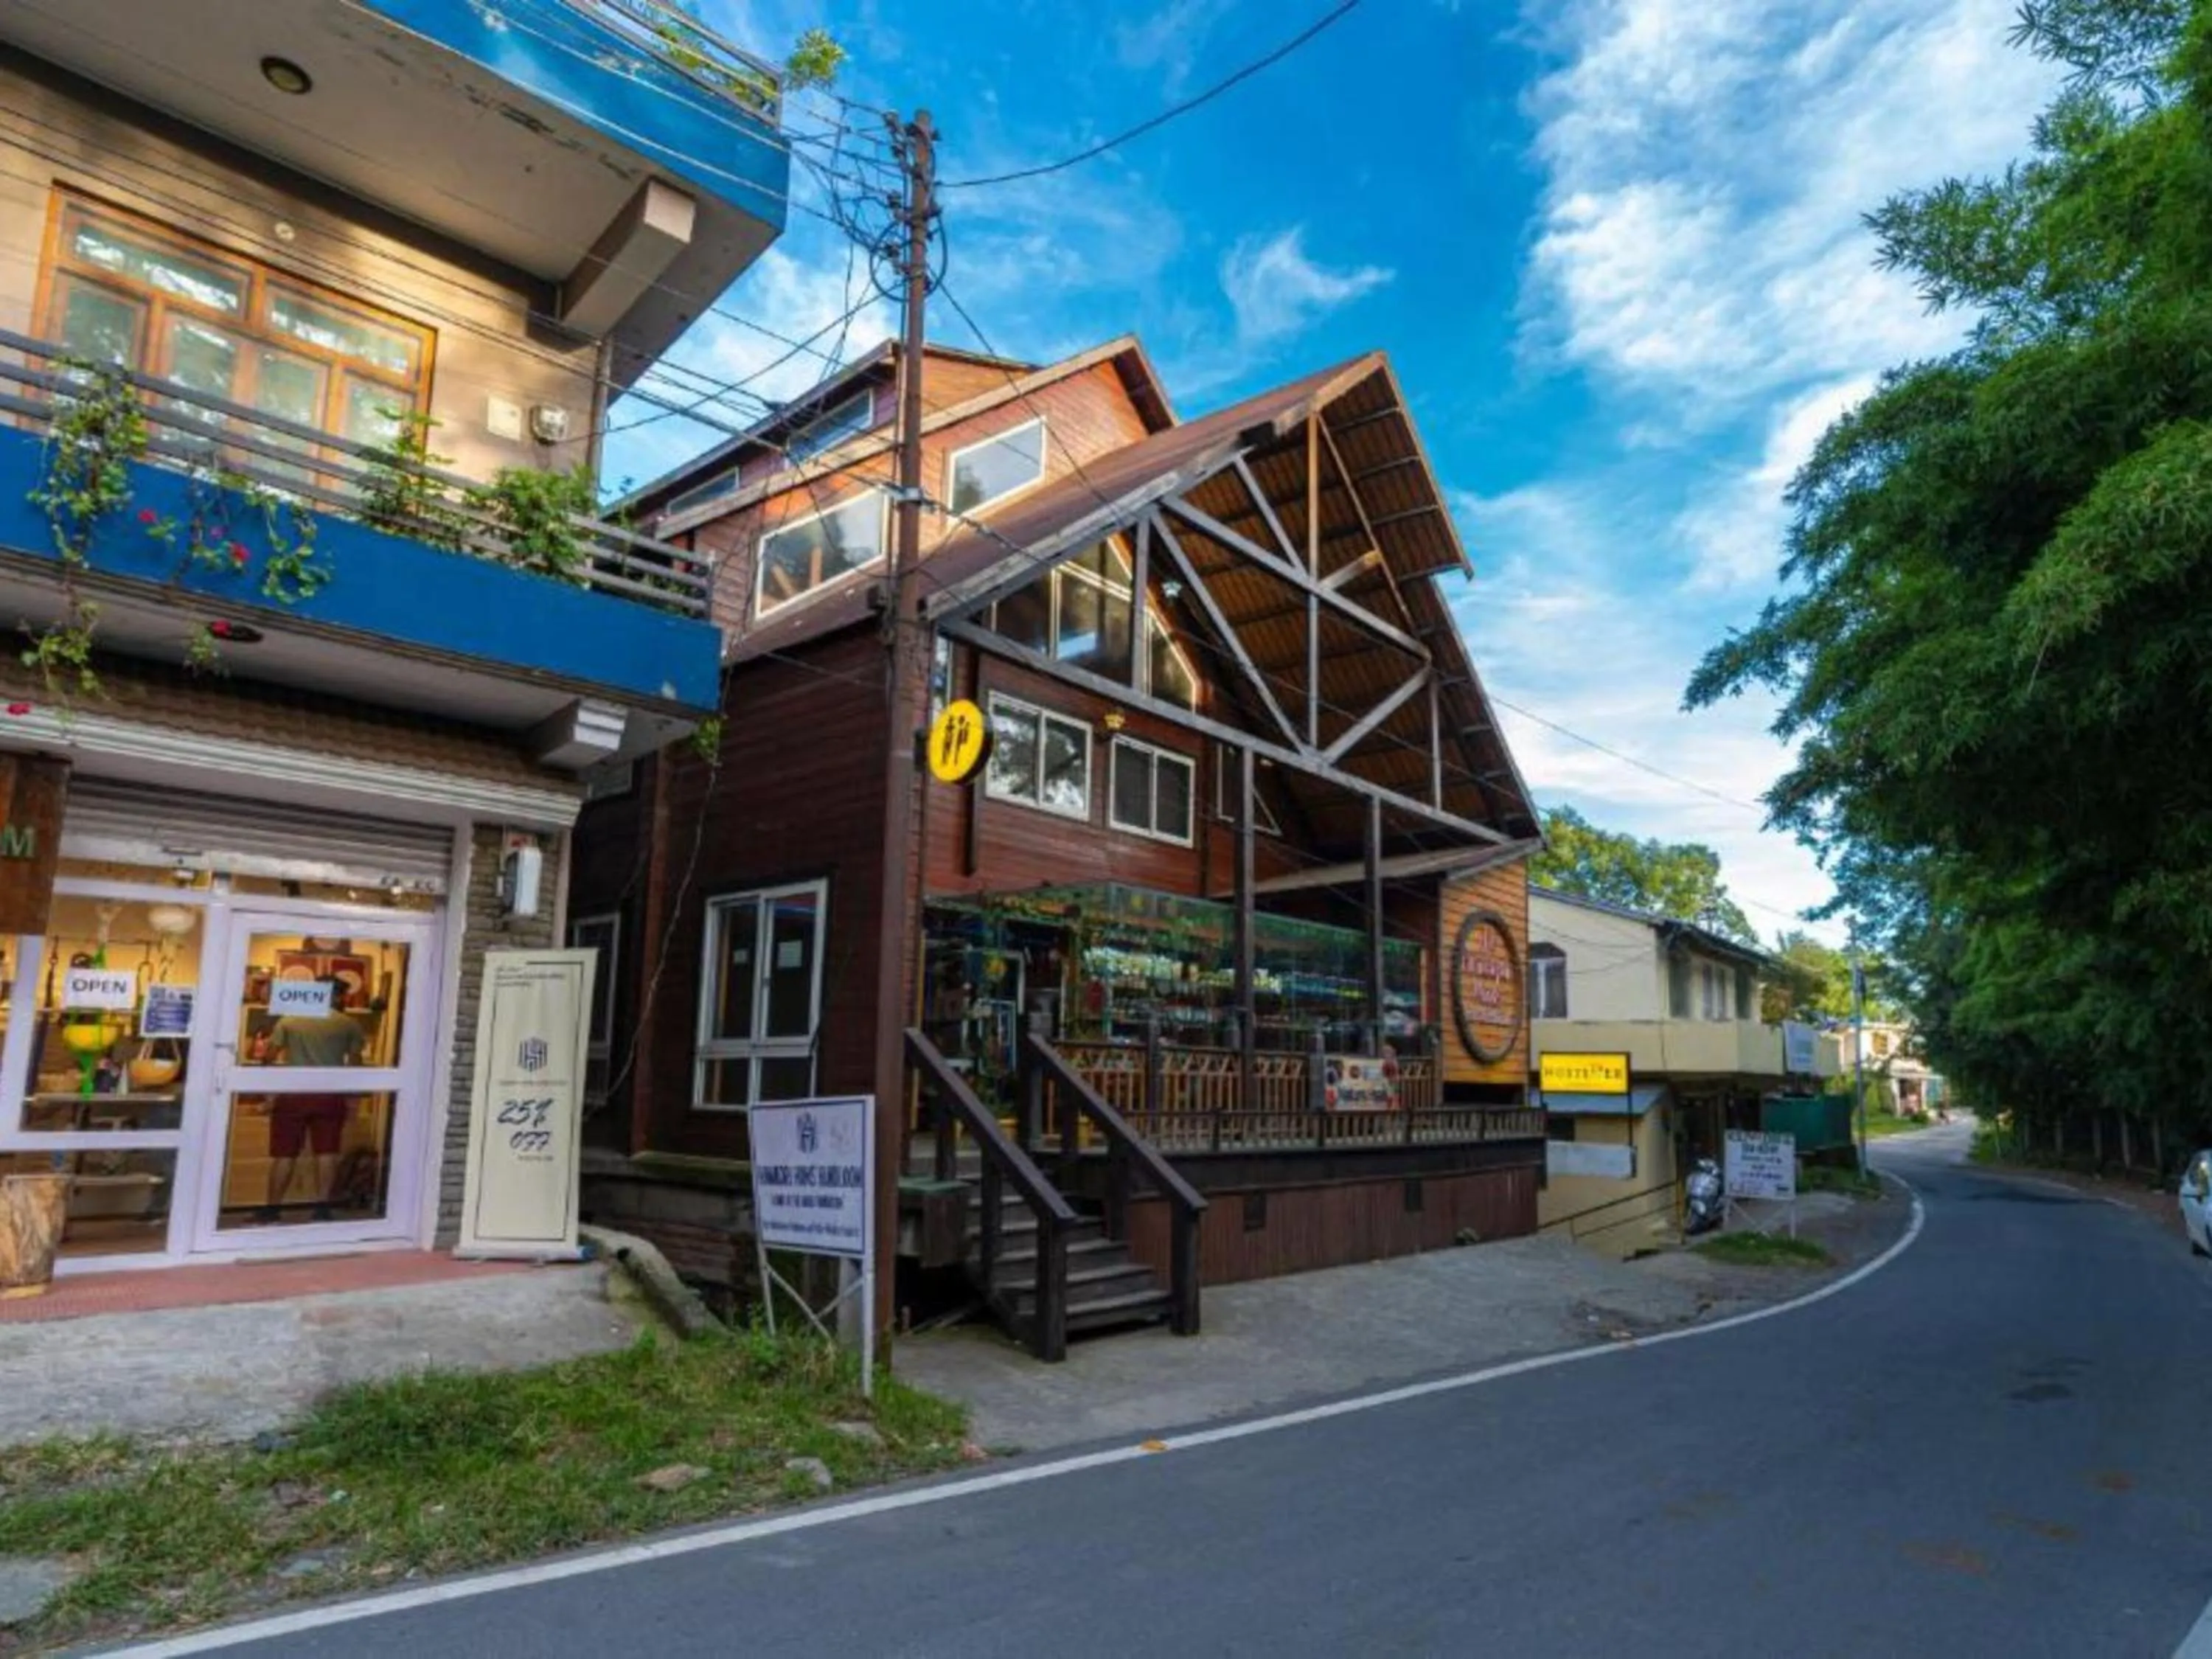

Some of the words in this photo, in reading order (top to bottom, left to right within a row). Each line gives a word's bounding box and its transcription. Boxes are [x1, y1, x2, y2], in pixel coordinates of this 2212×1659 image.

[72, 978, 127, 994] OPEN
[279, 990, 324, 1004] OPEN
[497, 1098, 554, 1128] 25%
[509, 1131, 550, 1152] OFF
